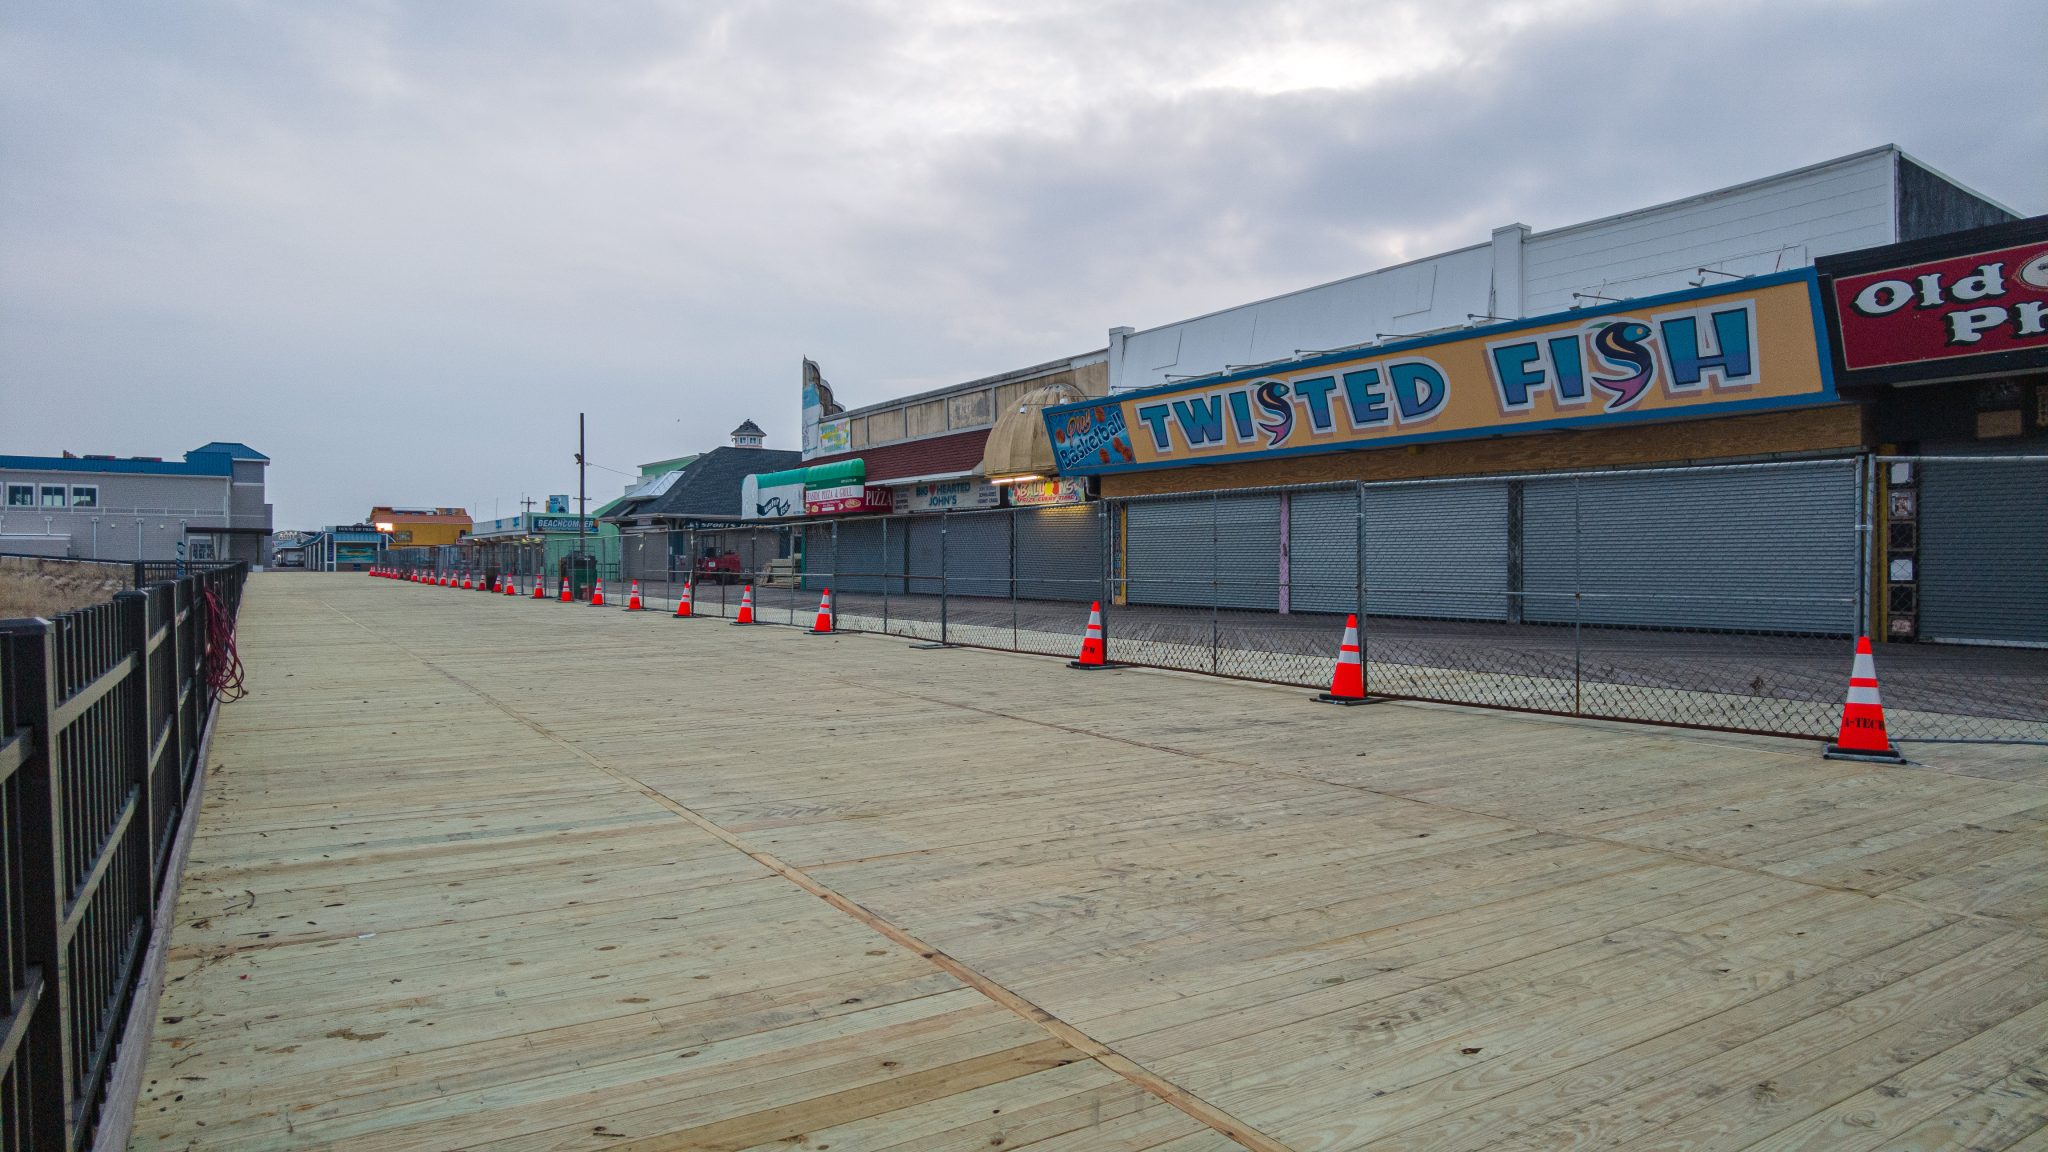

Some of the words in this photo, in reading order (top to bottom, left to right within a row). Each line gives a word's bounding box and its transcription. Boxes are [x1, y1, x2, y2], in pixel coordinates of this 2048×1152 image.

[1852, 262, 2008, 316] Old
[1137, 357, 1448, 450] TWISTED
[1488, 301, 1757, 411] FISH
[1059, 411, 1126, 470] Basketball
[821, 490, 834, 501] PIZZA
[840, 487, 853, 498] GRILL
[916, 485, 928, 497] BIG
[936, 482, 971, 495] HEARTED
[866, 490, 891, 506] PIZZA
[929, 495, 957, 506] JOHN'S
[538, 519, 594, 529] BEACHCOMER
